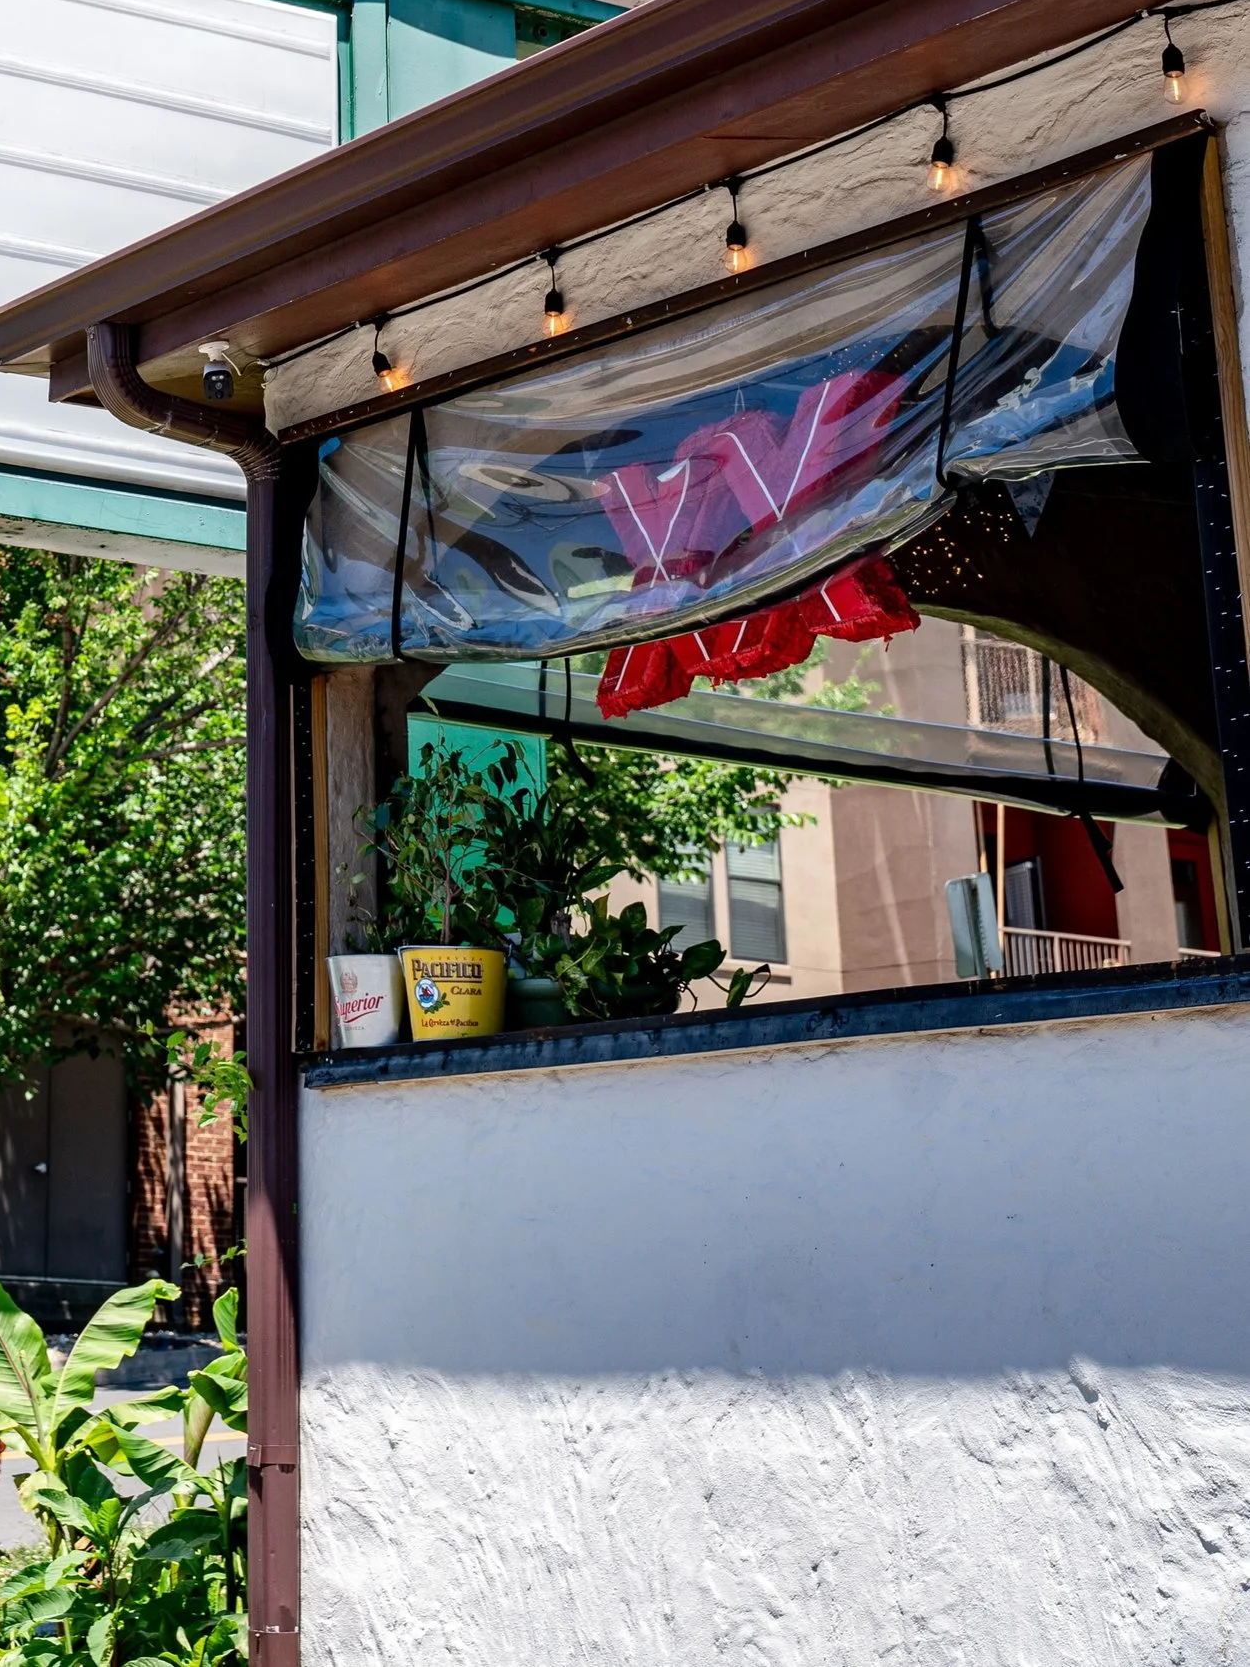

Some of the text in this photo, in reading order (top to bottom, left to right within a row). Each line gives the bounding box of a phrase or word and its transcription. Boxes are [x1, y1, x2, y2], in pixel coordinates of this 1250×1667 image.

[411, 957, 484, 981] PACIFICO
[450, 985, 483, 996] CLARA
[334, 992, 385, 1021] Superior
